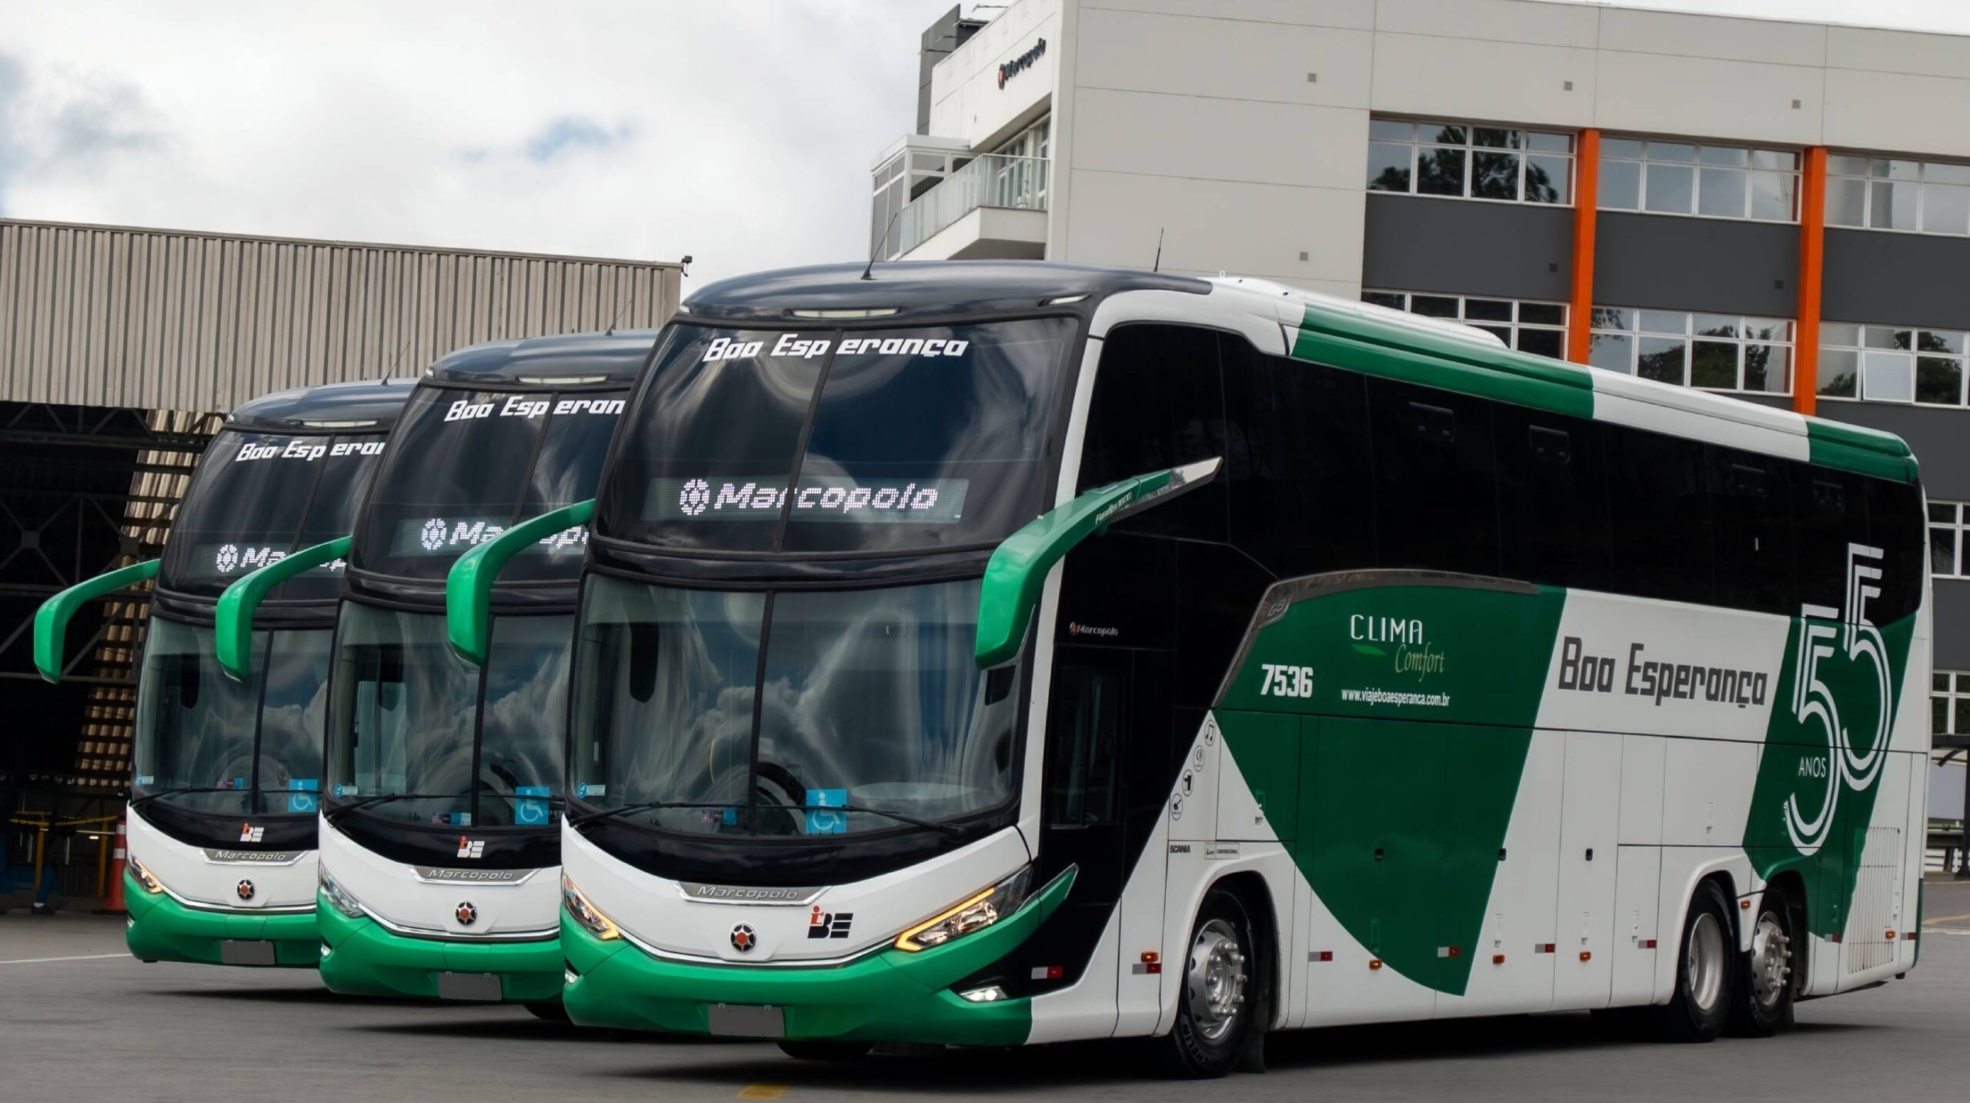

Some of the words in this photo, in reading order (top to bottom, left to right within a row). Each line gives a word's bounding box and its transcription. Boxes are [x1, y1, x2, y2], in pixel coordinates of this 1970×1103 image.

[714, 482, 938, 513] Marcopolo
[1350, 614, 1423, 645] CLIMA
[1395, 641, 1446, 683] Comfort
[1558, 636, 1616, 693] Boa
[1624, 642, 1768, 709] Esperança
[1260, 664, 1314, 698] 7536
[1798, 757, 1827, 779] ANOS
[214, 850, 287, 862] Marcopolo
[427, 868, 514, 881] Marcopolo
[696, 885, 800, 900] Marcopolo
